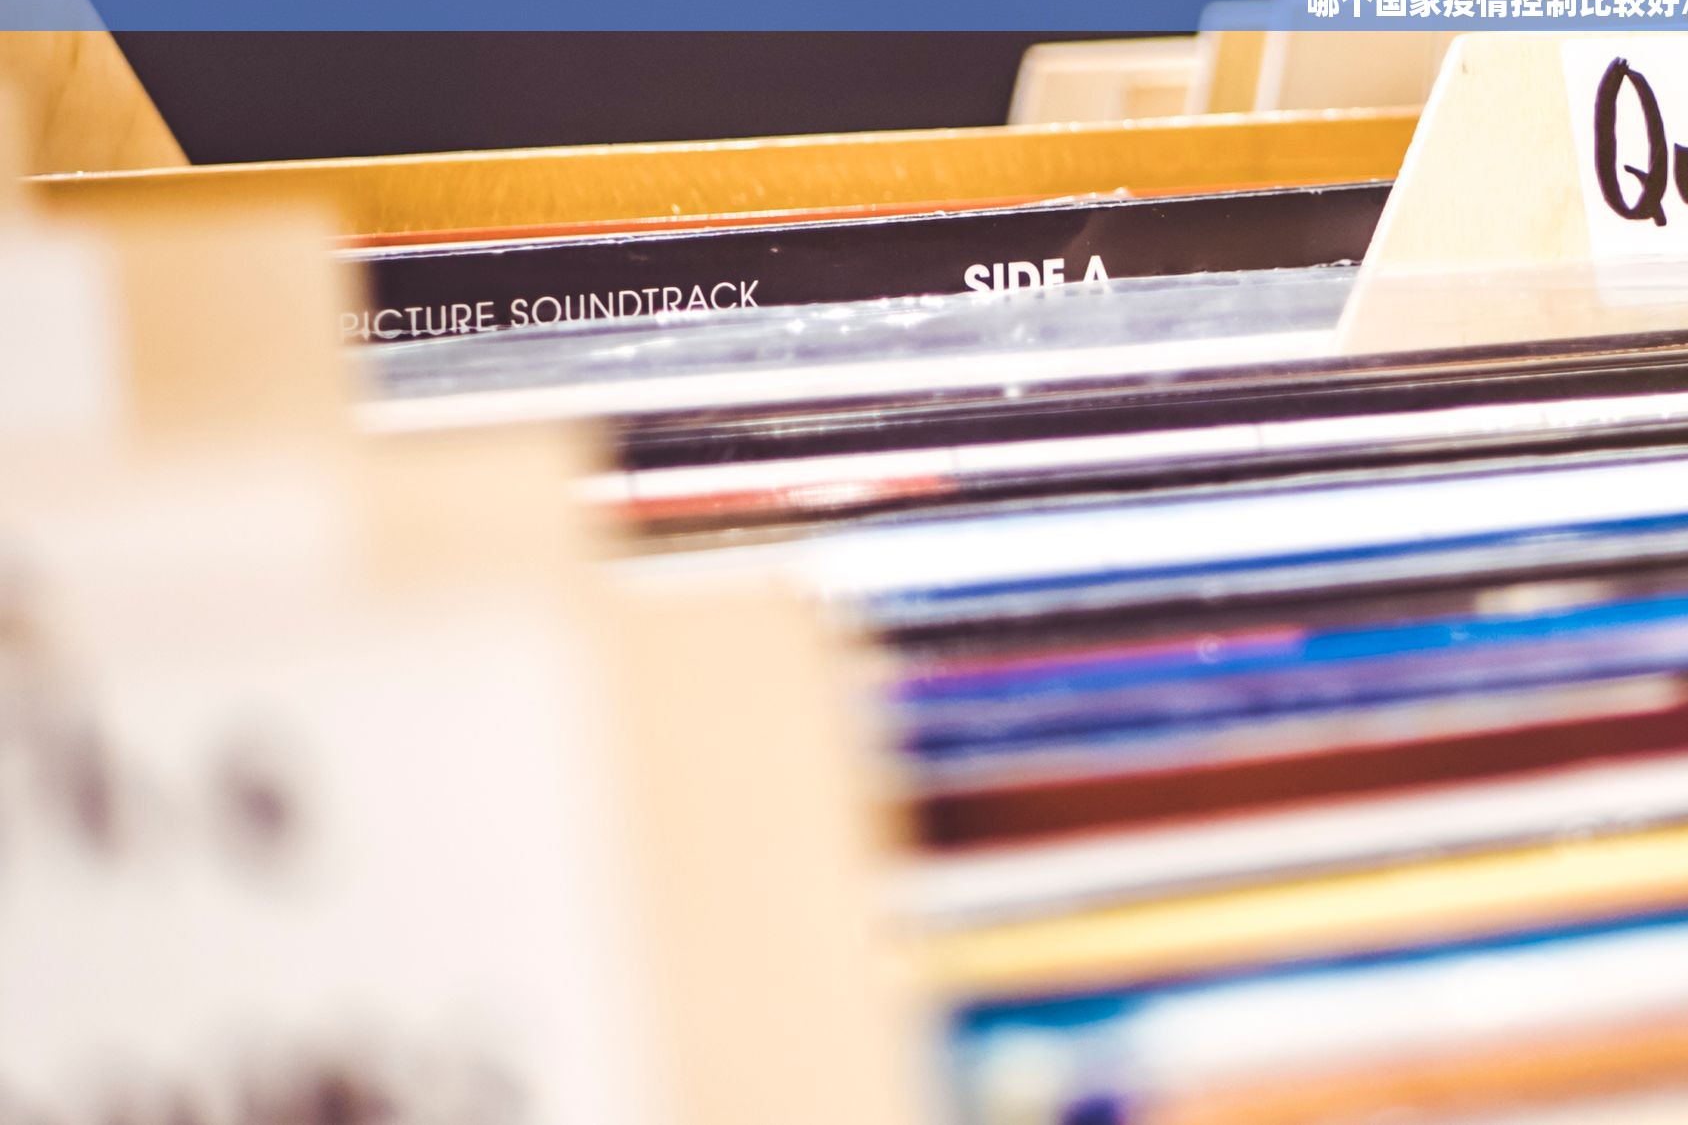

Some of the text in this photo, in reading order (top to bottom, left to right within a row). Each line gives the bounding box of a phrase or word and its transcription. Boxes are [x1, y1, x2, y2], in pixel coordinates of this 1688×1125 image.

[963, 254, 1110, 295] SIDE A
[341, 279, 759, 341] PICTURE SOUNDTRACK
